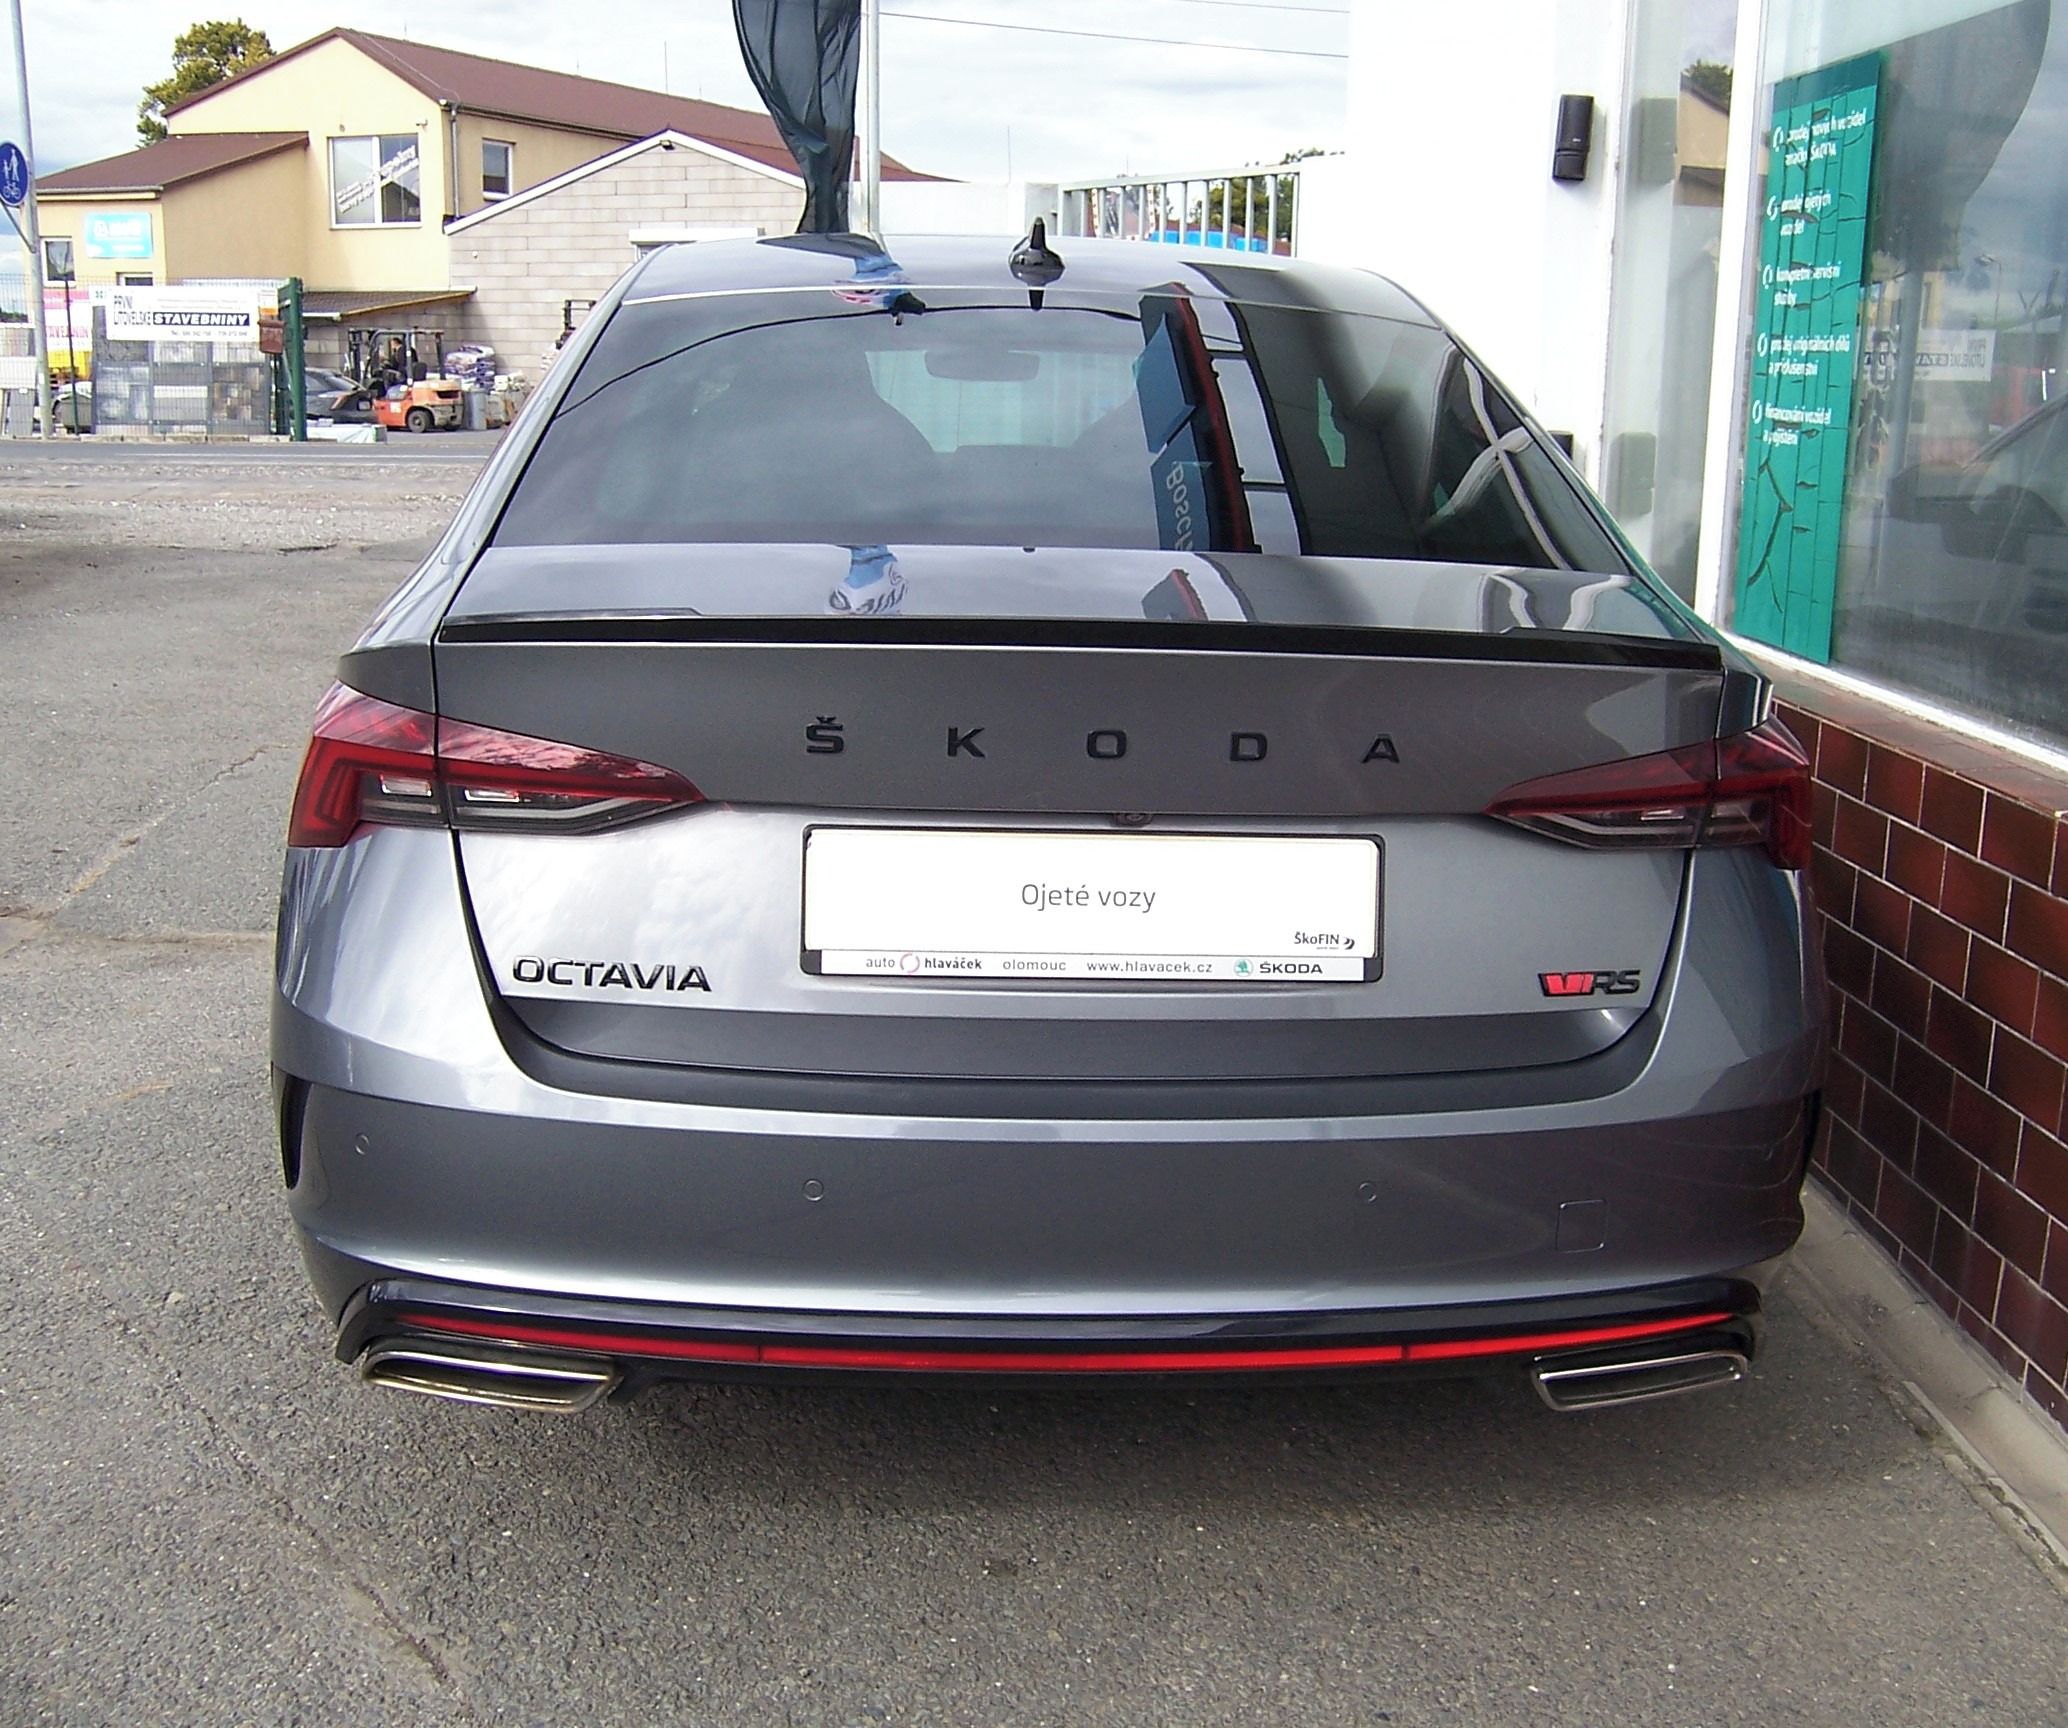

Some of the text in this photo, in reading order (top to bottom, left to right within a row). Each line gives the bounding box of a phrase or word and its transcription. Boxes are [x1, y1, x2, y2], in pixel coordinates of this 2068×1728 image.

[153, 312, 249, 326] STAVEBNINY
[1021, 883, 1156, 914] Ojeté vozy
[1294, 931, 1340, 946] ŠkoFIN
[512, 953, 713, 993] OCTAVIA
[865, 955, 1323, 975] auto hlaváček olomouc www.hlavacek.cz ŠKODA
